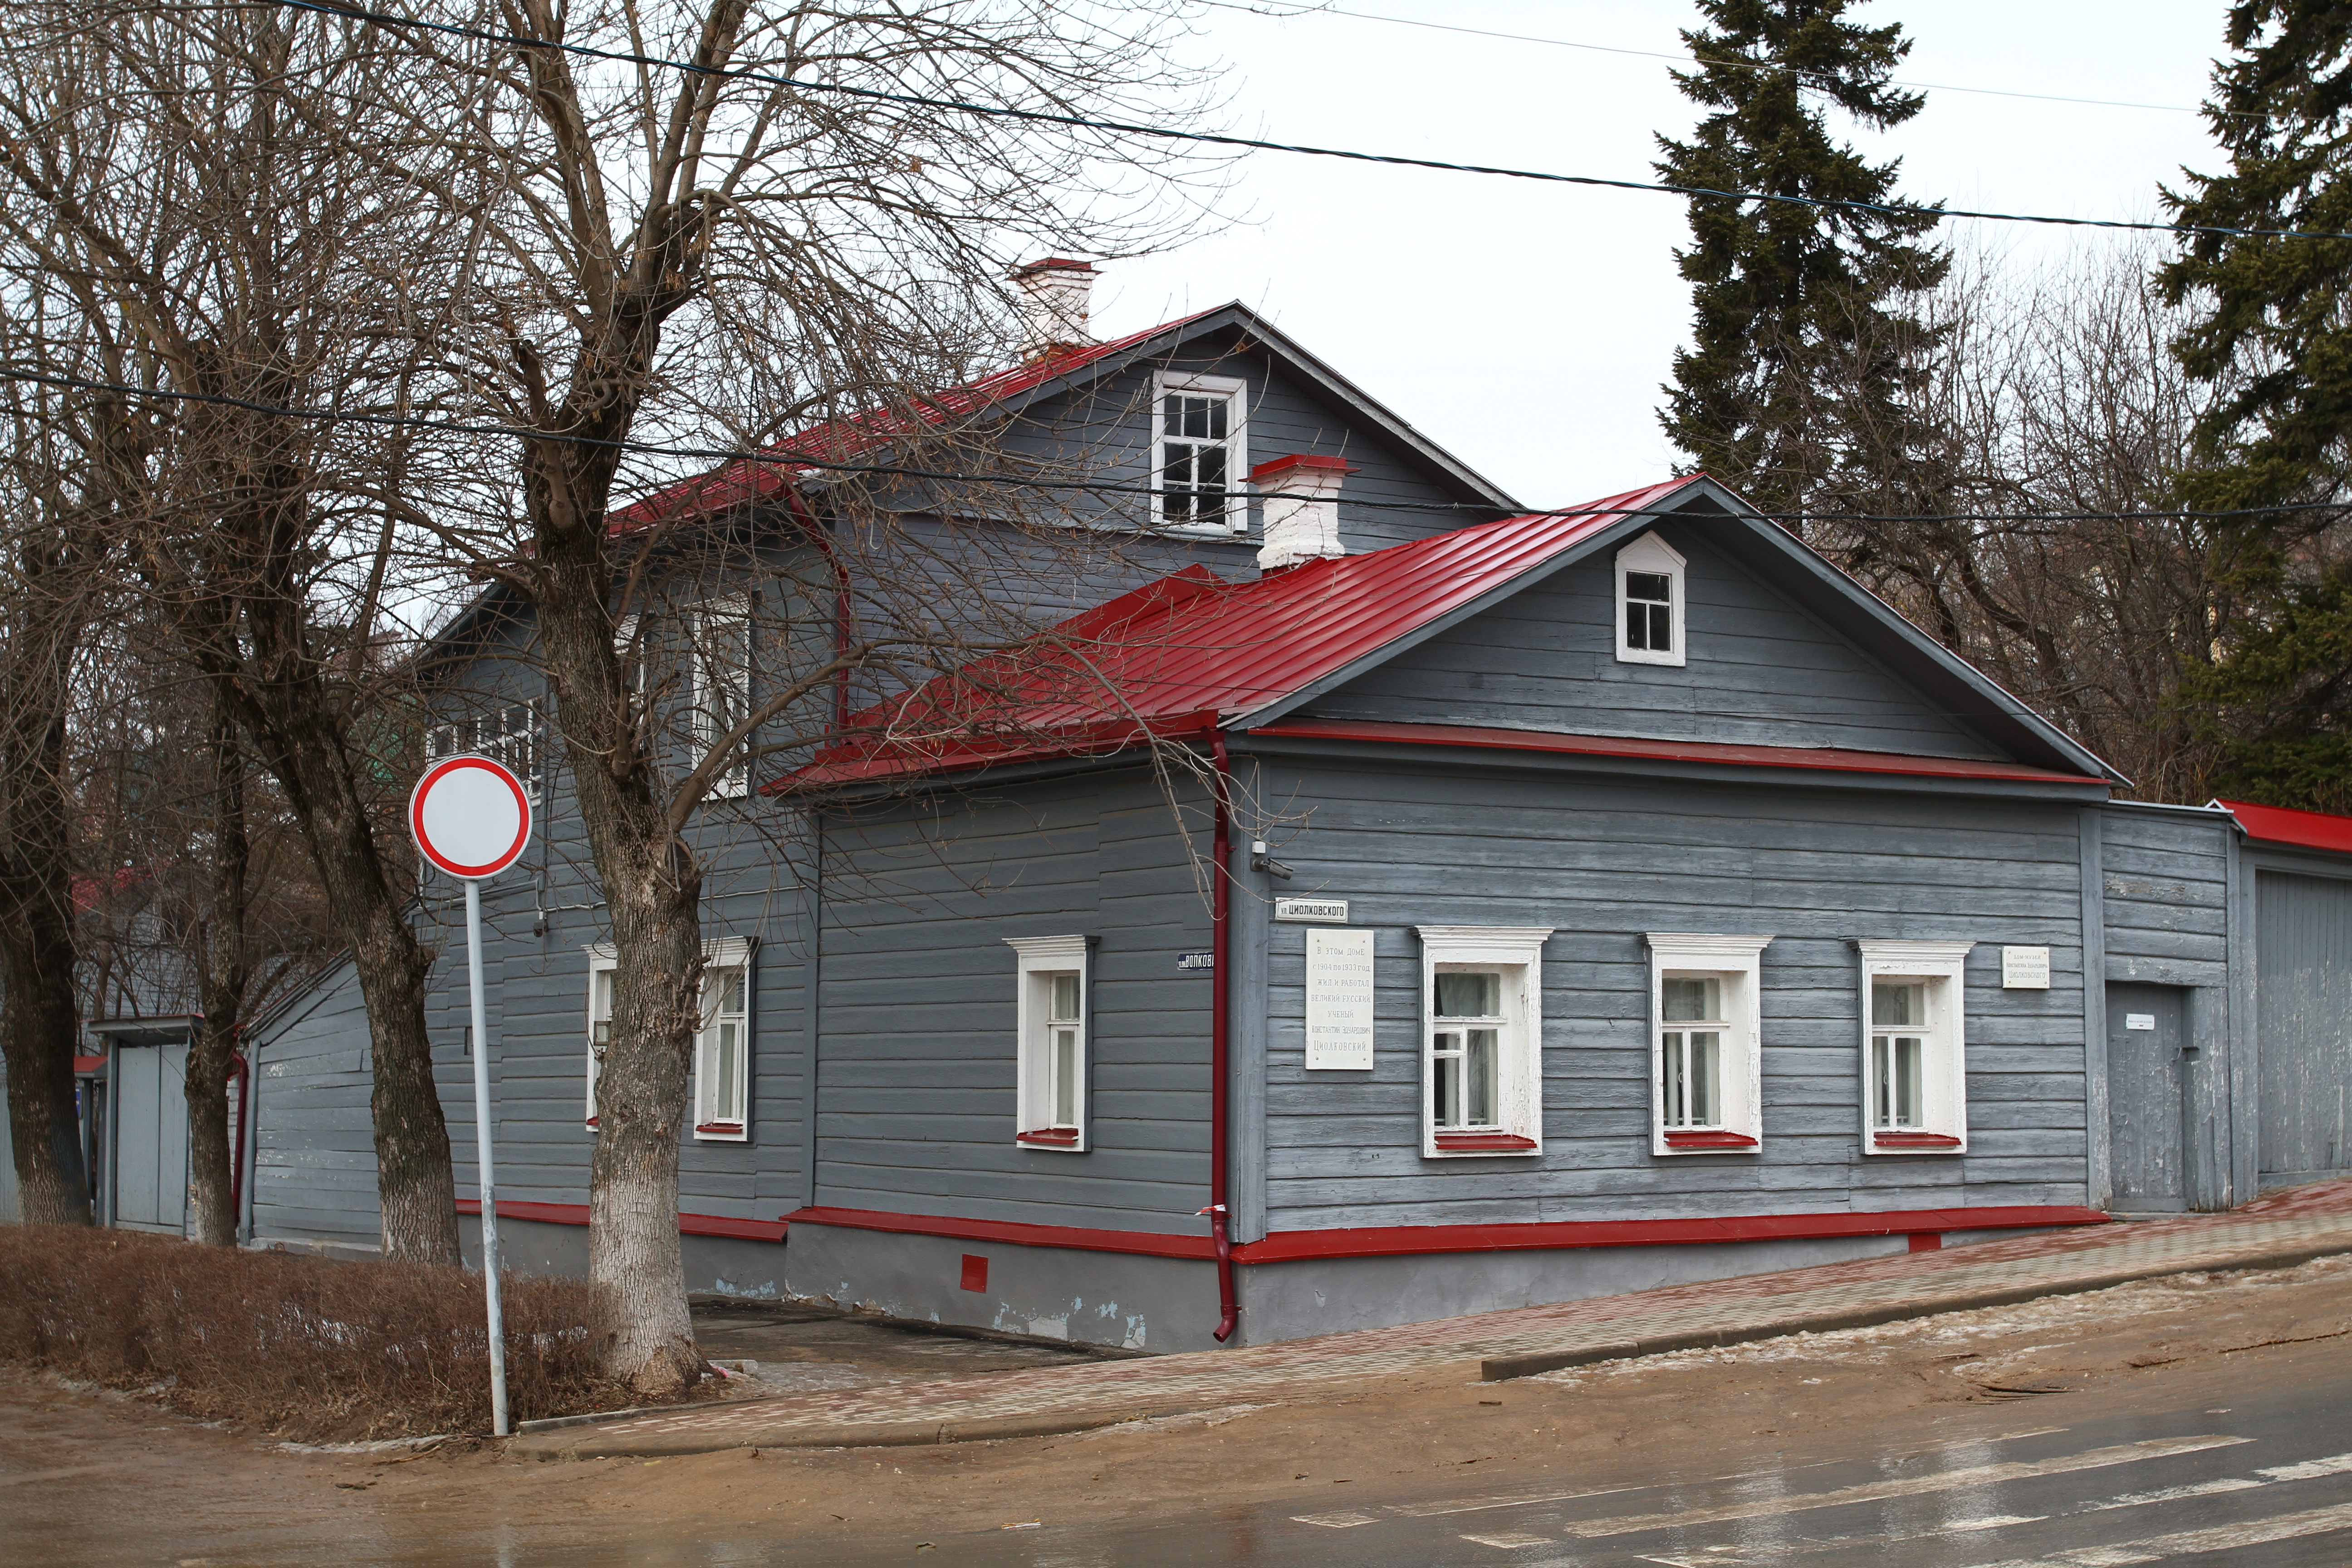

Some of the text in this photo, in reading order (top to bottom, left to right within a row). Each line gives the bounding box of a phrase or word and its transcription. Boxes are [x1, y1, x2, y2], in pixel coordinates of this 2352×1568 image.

[1289, 904, 1344, 916] ЦИОЛКОВСКОГО
[1317, 946, 1321, 955] В
[1347, 948, 1364, 956] ДОМЕ
[1311, 994, 1370, 1003] ВЕЛИКИЙ РУССКИЙ
[1328, 1009, 1354, 1018] УЧЕНЫЙ
